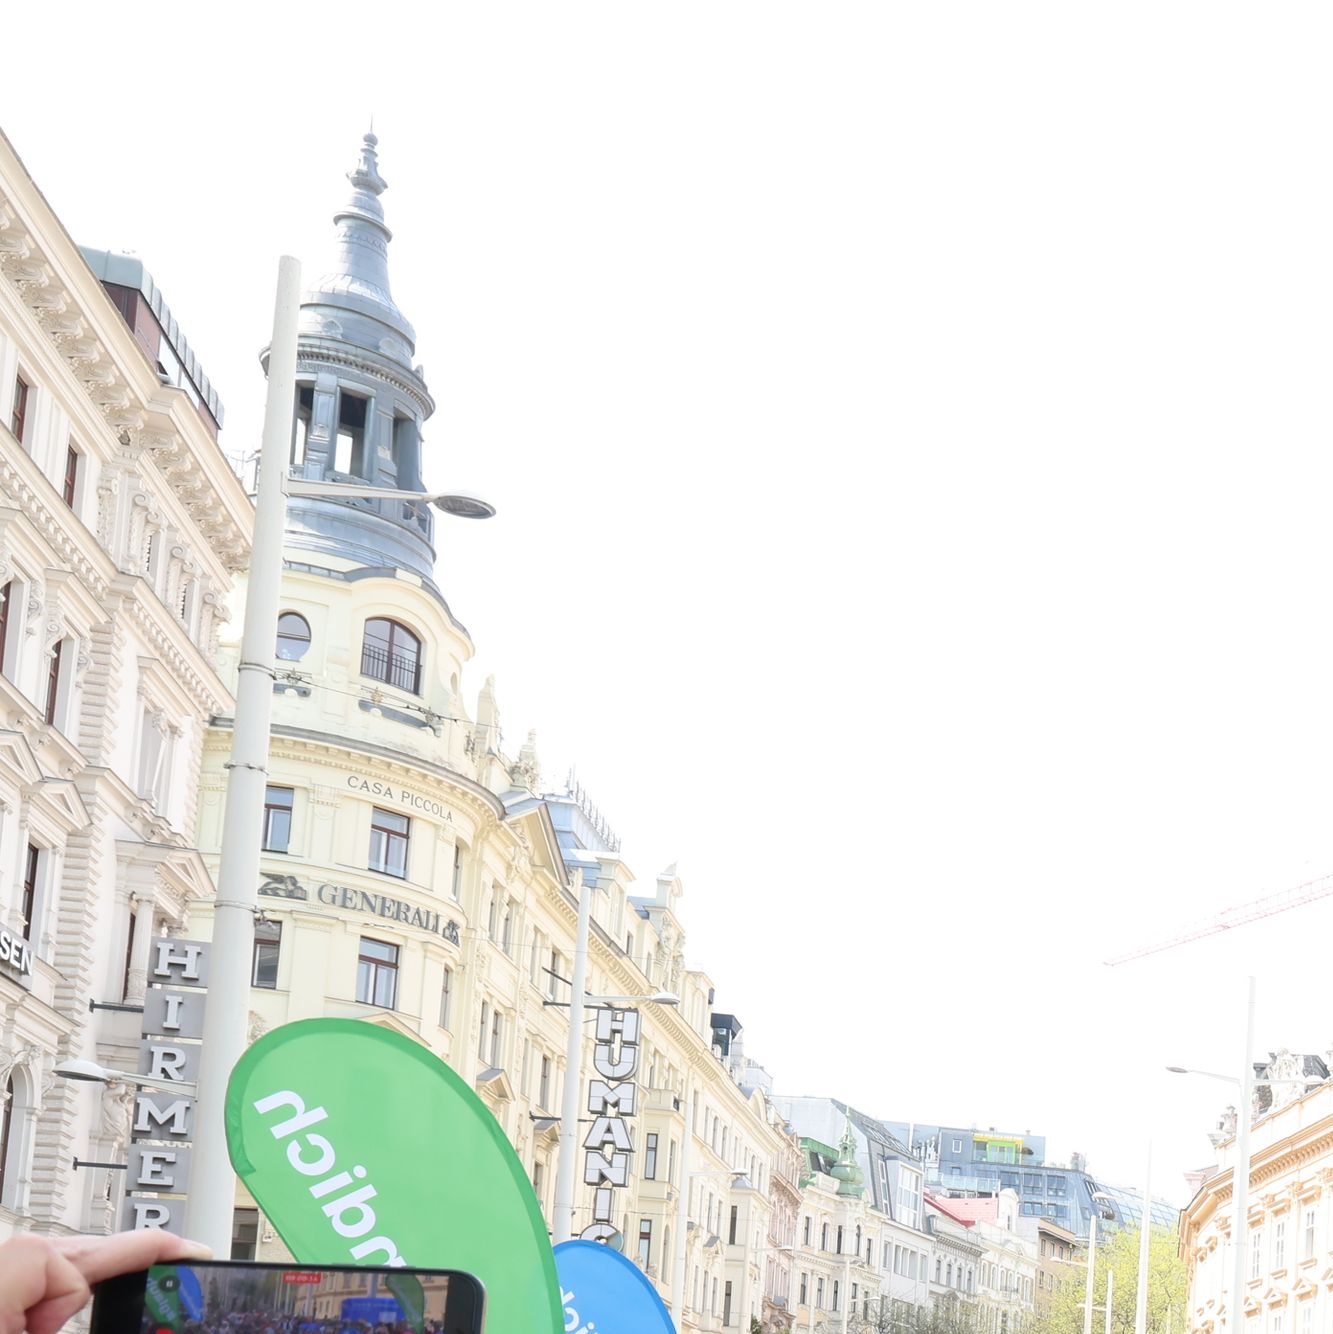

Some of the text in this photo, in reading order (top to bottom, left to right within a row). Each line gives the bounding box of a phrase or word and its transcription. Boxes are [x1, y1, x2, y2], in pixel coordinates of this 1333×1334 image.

[346, 775, 453, 823] CASA PICCOLA
[317, 884, 441, 935] GENERALI
[133, 942, 203, 1231] HIRMER
